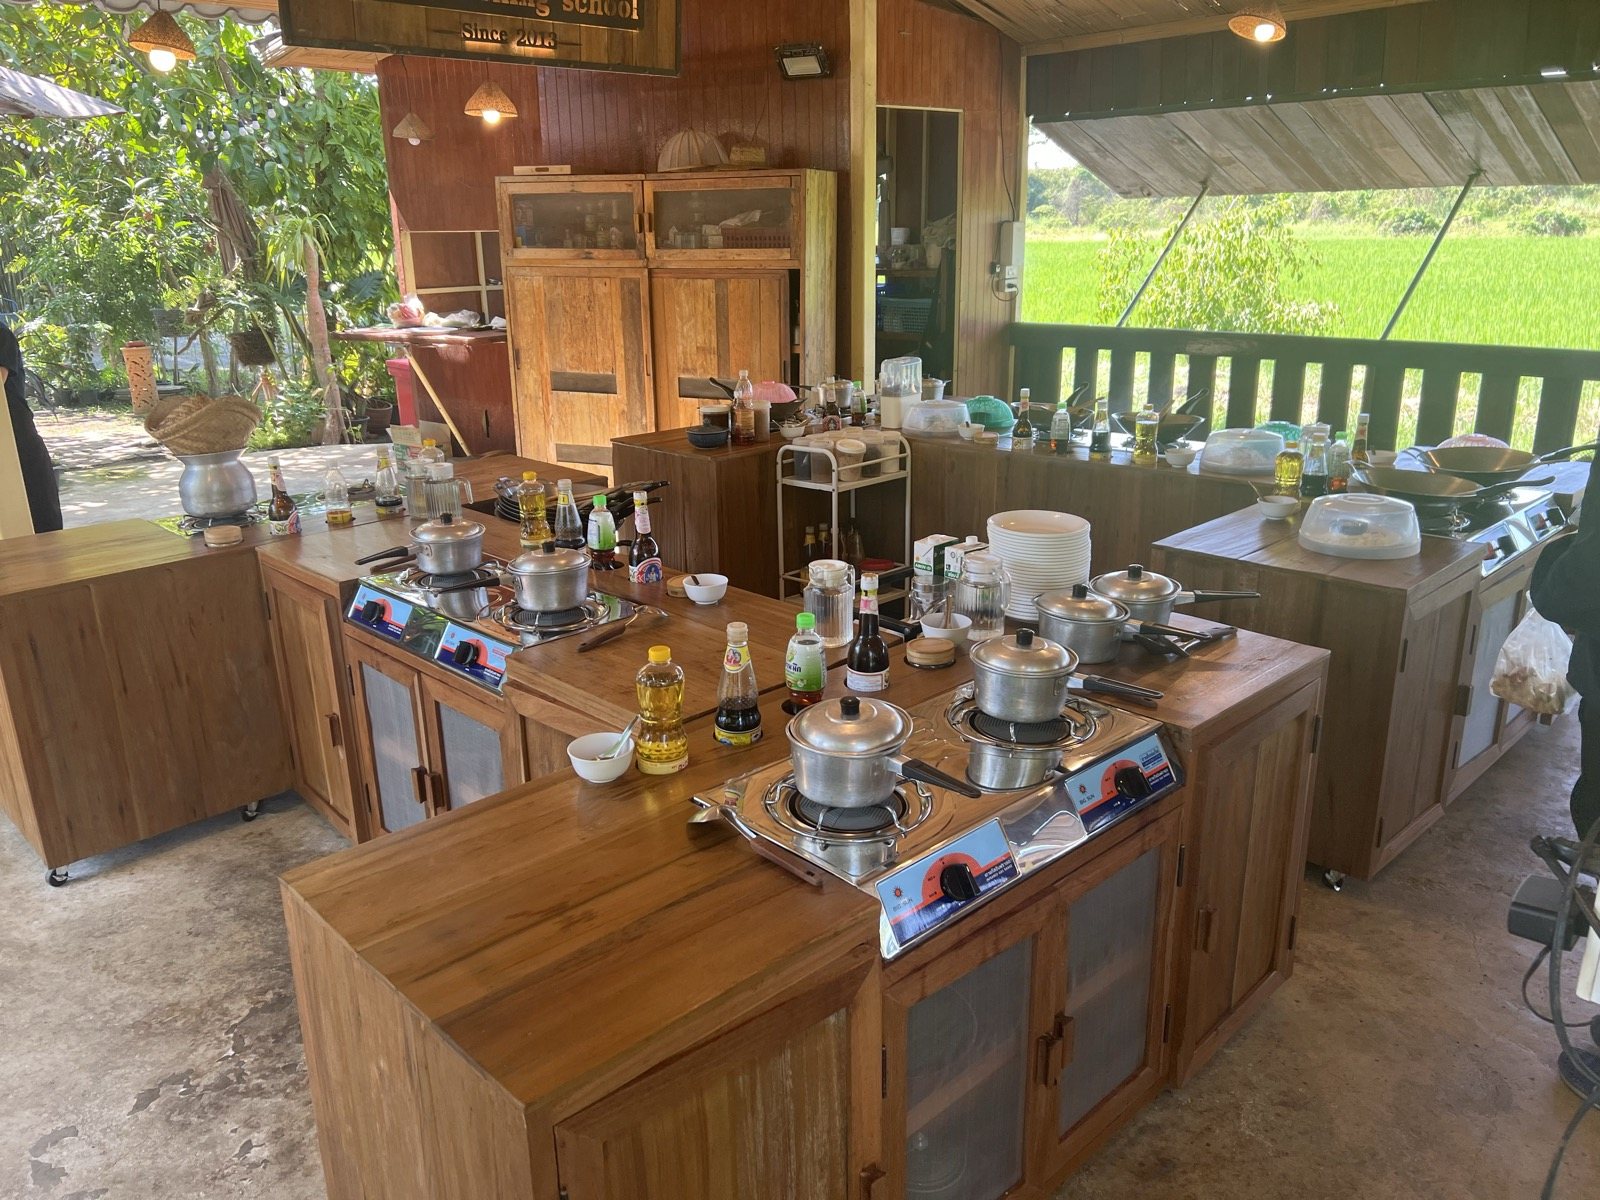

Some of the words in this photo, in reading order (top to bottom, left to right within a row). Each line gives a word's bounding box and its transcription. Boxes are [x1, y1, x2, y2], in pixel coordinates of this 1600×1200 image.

[562, 0, 639, 20] school
[462, 22, 508, 42] Since
[516, 28, 558, 49] 2013
